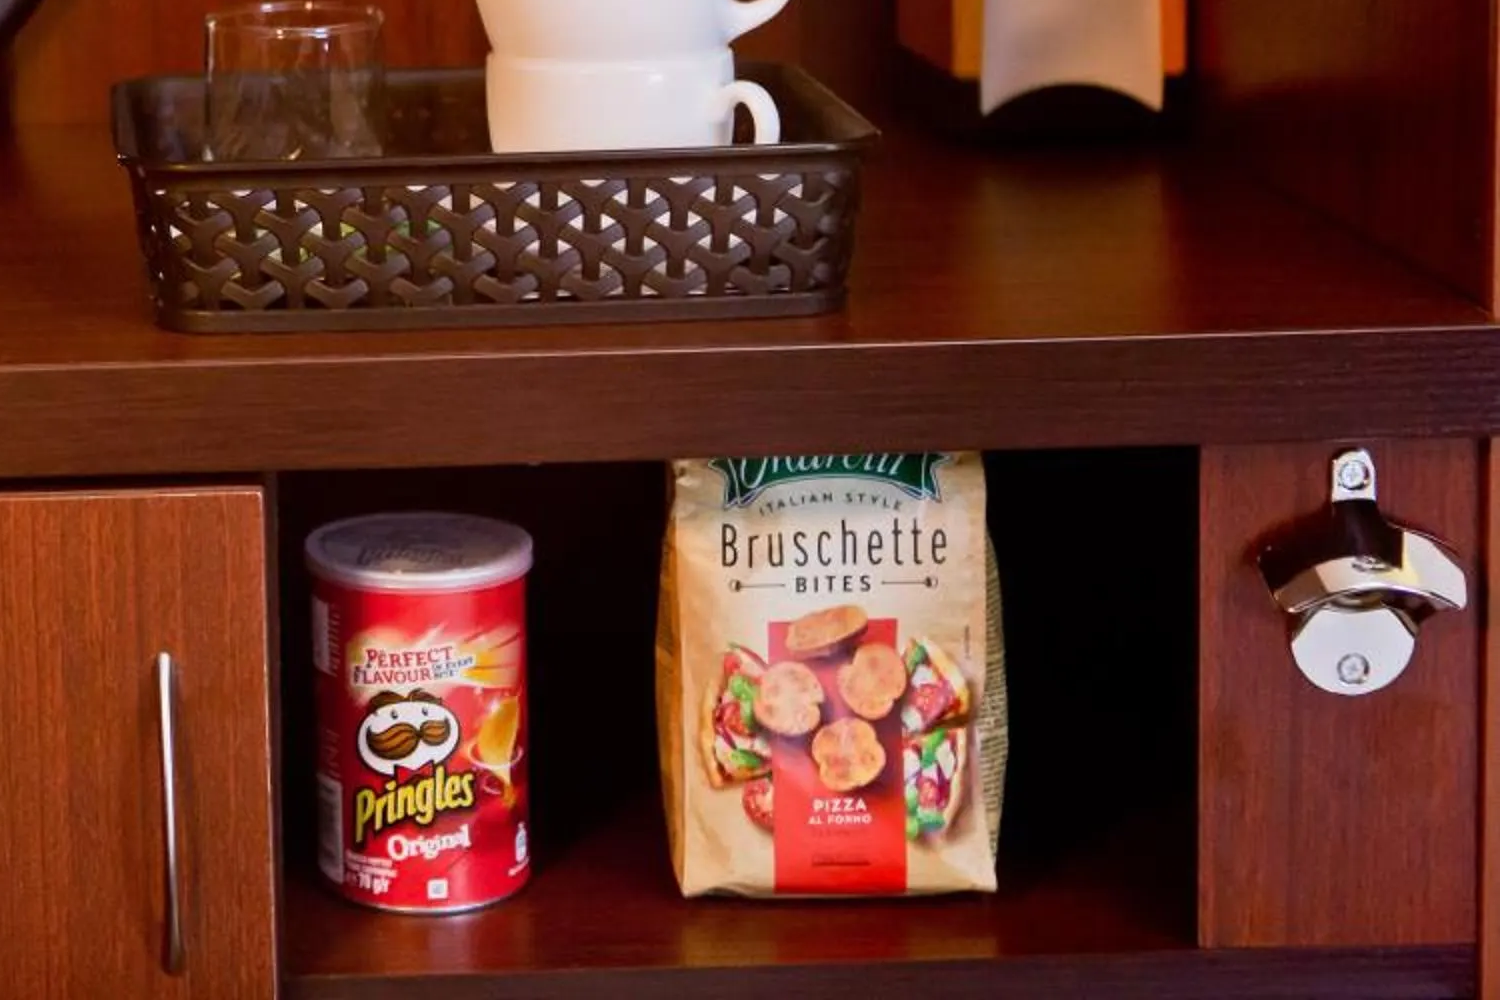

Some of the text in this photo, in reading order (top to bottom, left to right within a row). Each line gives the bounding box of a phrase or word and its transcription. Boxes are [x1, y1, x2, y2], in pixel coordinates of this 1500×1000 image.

[758, 490, 904, 517] ITALIAN STYLE
[720, 516, 948, 569] Bruschette
[794, 574, 872, 594] BITES
[365, 645, 453, 669] PERFECT
[352, 664, 432, 685] FLAVOUR
[355, 765, 475, 844] Pringles
[812, 797, 868, 813] PIZZA
[807, 812, 873, 825] AL FORNO
[387, 823, 472, 861] Original
